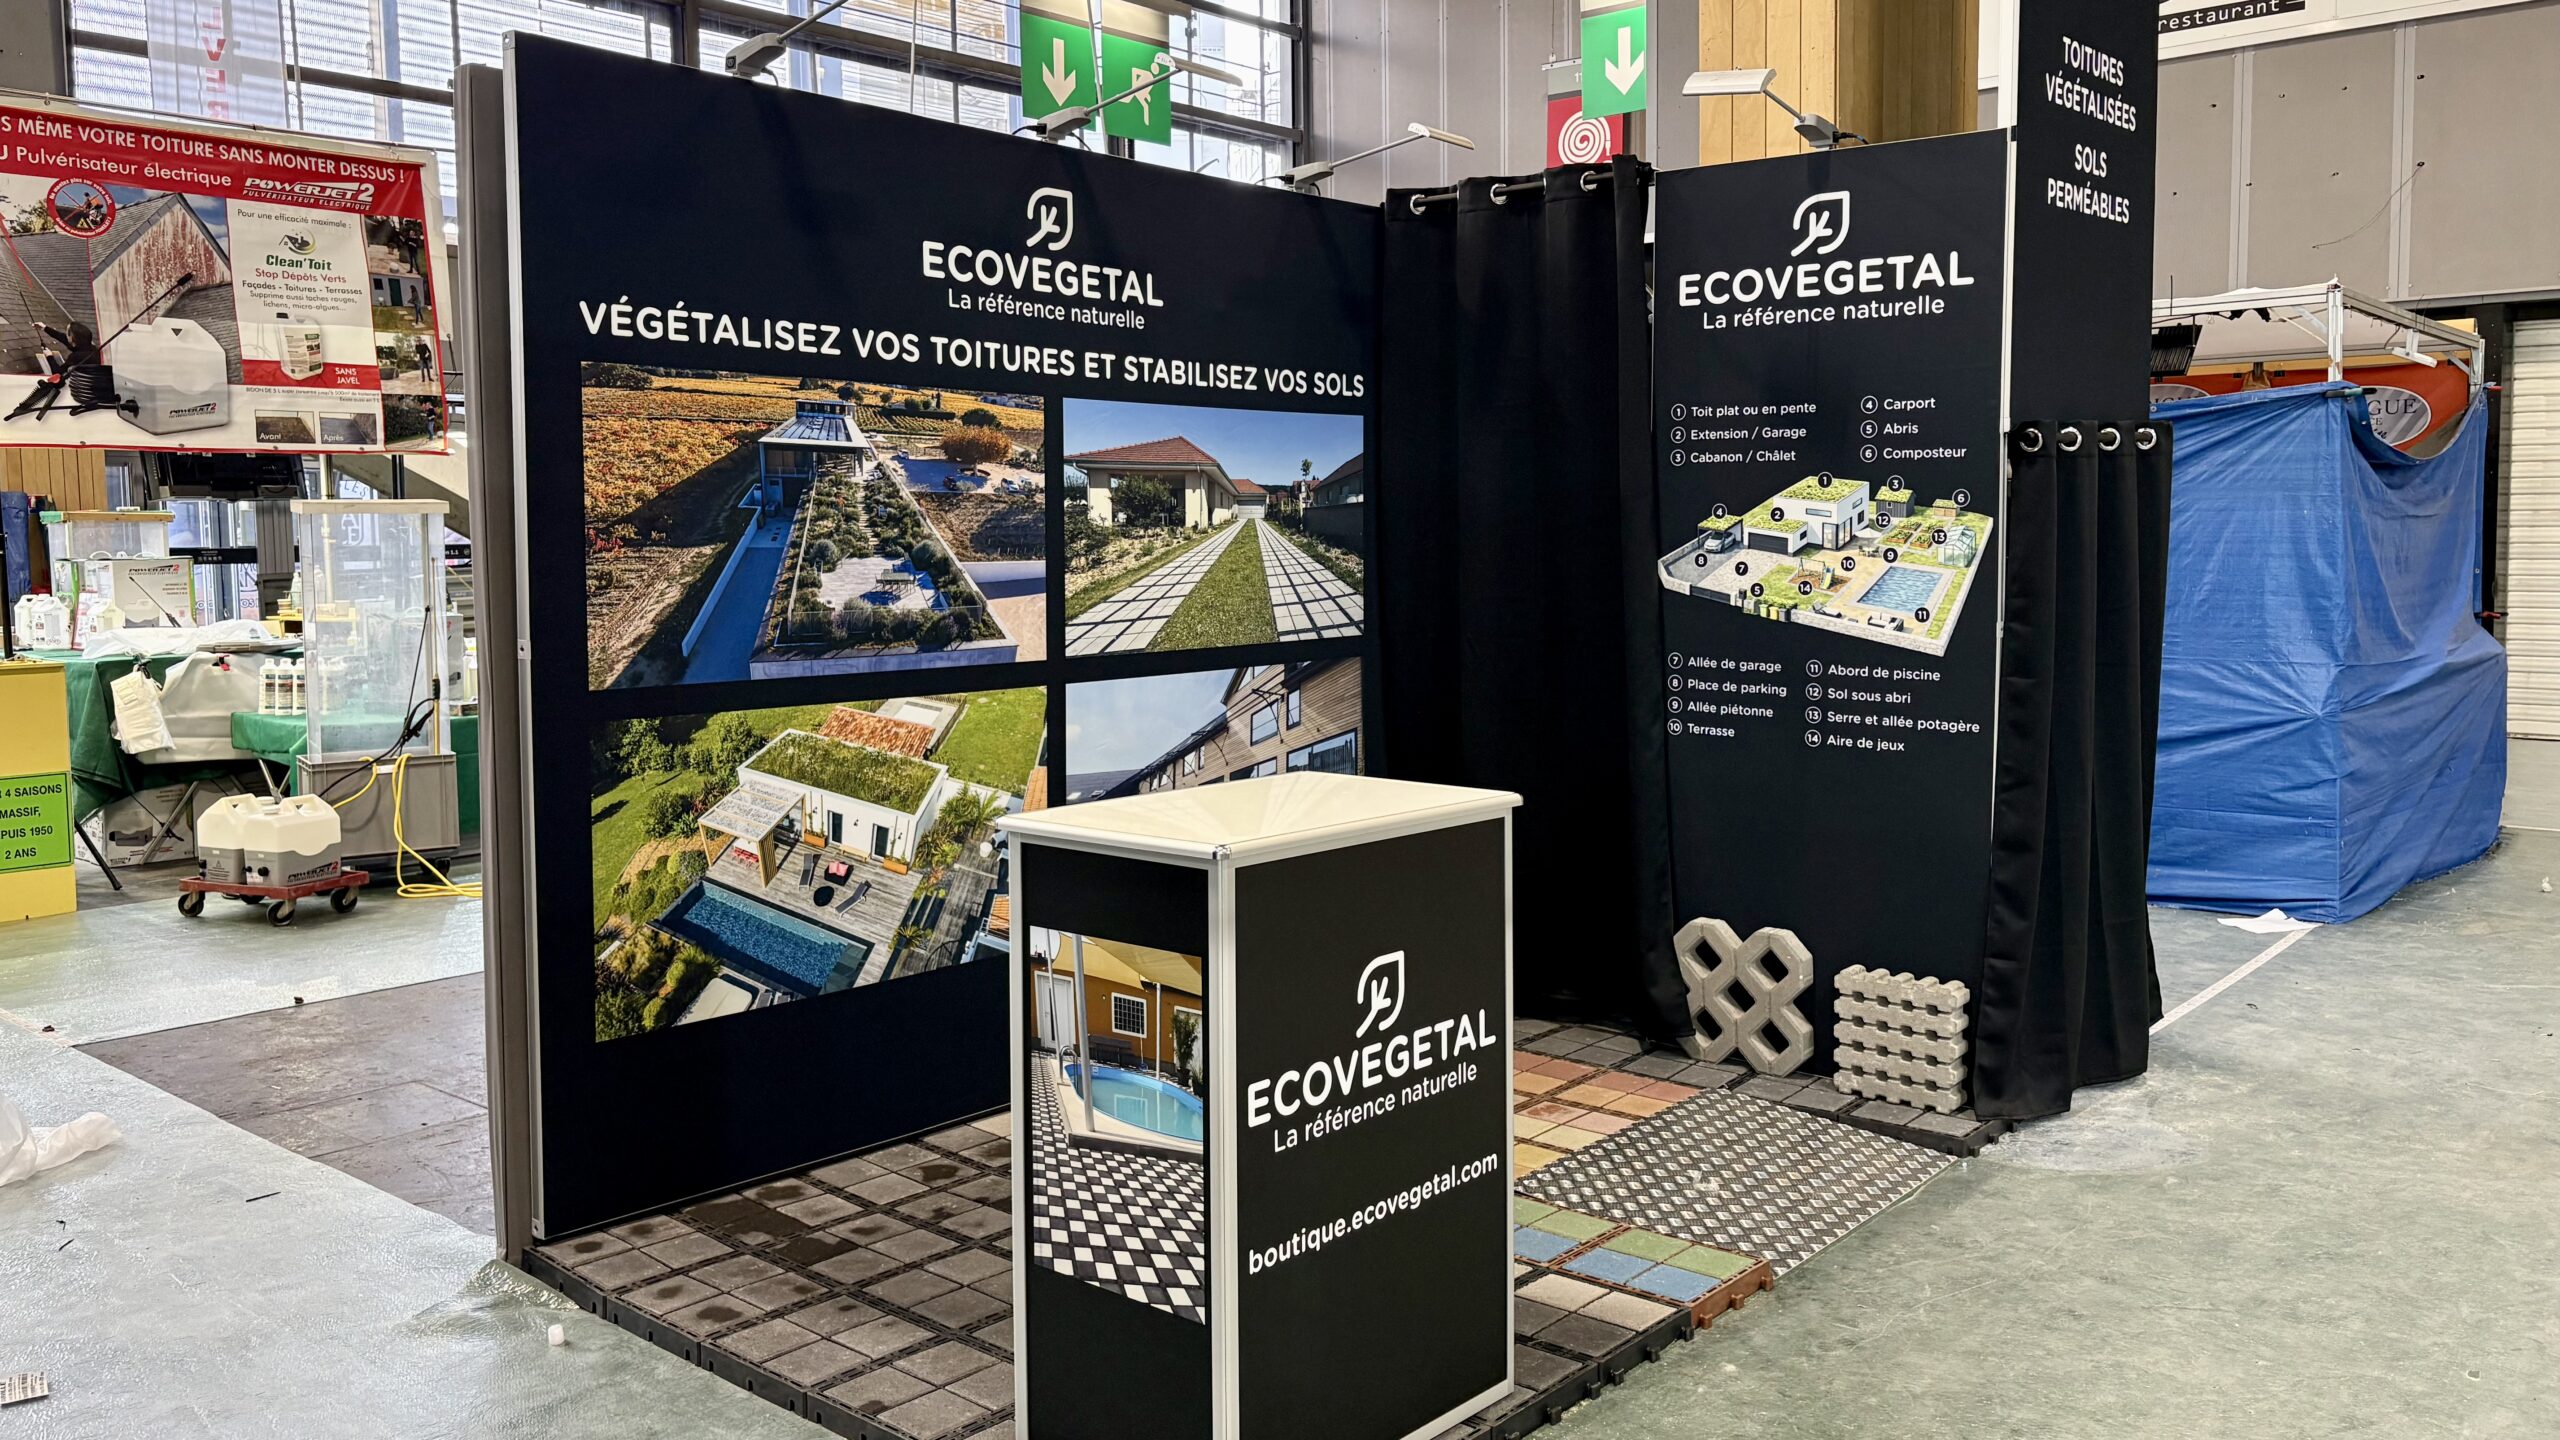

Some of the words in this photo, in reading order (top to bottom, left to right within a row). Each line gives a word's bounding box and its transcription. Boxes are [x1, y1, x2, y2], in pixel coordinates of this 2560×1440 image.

[2158, 0, 2280, 31] restaurant
[2062, 35, 2124, 87] TOITURES
[2045, 70, 2137, 132] VÉGÉTALISÉES
[18, 115, 72, 140] MÊME
[78, 125, 136, 148] VOTRE
[141, 133, 214, 158] TOITURE
[219, 144, 264, 165] SANS
[268, 151, 335, 174] MONTER
[340, 161, 396, 183] DESSUS
[17, 146, 139, 175] Pulvérisateur
[144, 163, 232, 190] électrique
[2074, 143, 2108, 178] SOLS
[2047, 177, 2130, 224] PERMÉABLES
[237, 209, 255, 218] Pour
[257, 213, 273, 221] une
[274, 213, 309, 225] efficacité
[311, 218, 347, 229] maximale
[266, 254, 332, 271] Clean'Toit
[255, 268, 279, 280] Stop
[282, 270, 318, 283] Dépôts
[321, 274, 347, 283] Verts
[922, 240, 1164, 307] ECOVEGETAL
[1678, 251, 1975, 307] ECOVEGETAL
[242, 280, 276, 290] Façades
[284, 283, 317, 292] Toitures
[325, 286, 363, 295] Terrasses
[948, 288, 972, 310] La
[978, 292, 1066, 321] référence
[1072, 306, 1145, 330] naturelle
[1703, 311, 1727, 330] La
[1733, 306, 1836, 328] référence
[1843, 294, 1945, 320] naturelle
[579, 295, 842, 356] VÉGÉTALISEZ
[852, 327, 920, 363] VOS
[929, 335, 1076, 377] TOITURES
[1084, 351, 1116, 380] ET
[1123, 355, 1258, 391] STABILISEZ
[1264, 367, 1308, 394] VOS
[1313, 371, 1364, 398] SOLS
[335, 367, 357, 376] SANS
[337, 376, 360, 385] JAVEL
[1691, 405, 1713, 417] Toit
[1717, 404, 1739, 419] plat
[1743, 407, 1758, 416] ou
[1762, 406, 1777, 415] en
[1780, 402, 1817, 418] pente
[1883, 397, 1936, 412] Carport
[1690, 427, 1749, 441] Extension
[1762, 426, 1807, 440] Garage
[1883, 422, 1919, 435] Abris
[1690, 450, 1743, 463] Cabanon
[1756, 448, 1796, 462] Châlet
[1883, 447, 1967, 462] Composteur
[1688, 656, 1717, 668] Allée
[1720, 658, 1736, 669] de
[1739, 661, 1782, 674] garage
[1828, 664, 1869, 677] Abord
[1872, 666, 1890, 678] de
[1893, 667, 1941, 681] piscine
[1687, 678, 1719, 690] Place
[1722, 681, 1738, 692] de
[1741, 683, 1787, 697] parking
[1827, 688, 1848, 700] Sol
[1851, 691, 1882, 702] sous
[1885, 692, 1911, 704] abri
[1687, 701, 1717, 713] Allée
[1720, 704, 1774, 718] piétonne
[1687, 723, 1735, 737] Terrasse
[1827, 711, 1862, 725] Serre
[1865, 715, 1879, 726] et
[1882, 716, 1914, 728] allée
[1917, 719, 1980, 734] potagère
[1827, 735, 1854, 747] Aire
[1857, 737, 1874, 749] de
[1877, 738, 1905, 751] jeux
[5, 788, 12, 798] 4
[14, 783, 62, 798] SAISONS
[0, 806, 41, 819] MASSIF,
[1, 828, 26, 839] PUIS
[29, 825, 53, 837] 1950
[5, 850, 12, 860] 2
[14, 847, 37, 859] ANS
[1247, 1008, 1497, 1128] ECOVEGETAL
[1274, 1129, 1298, 1153] La
[1305, 1093, 1396, 1142] référence
[1401, 1061, 1478, 1106] naturelle
[1248, 1153, 1498, 1275] boutique.ecovegetal.com
